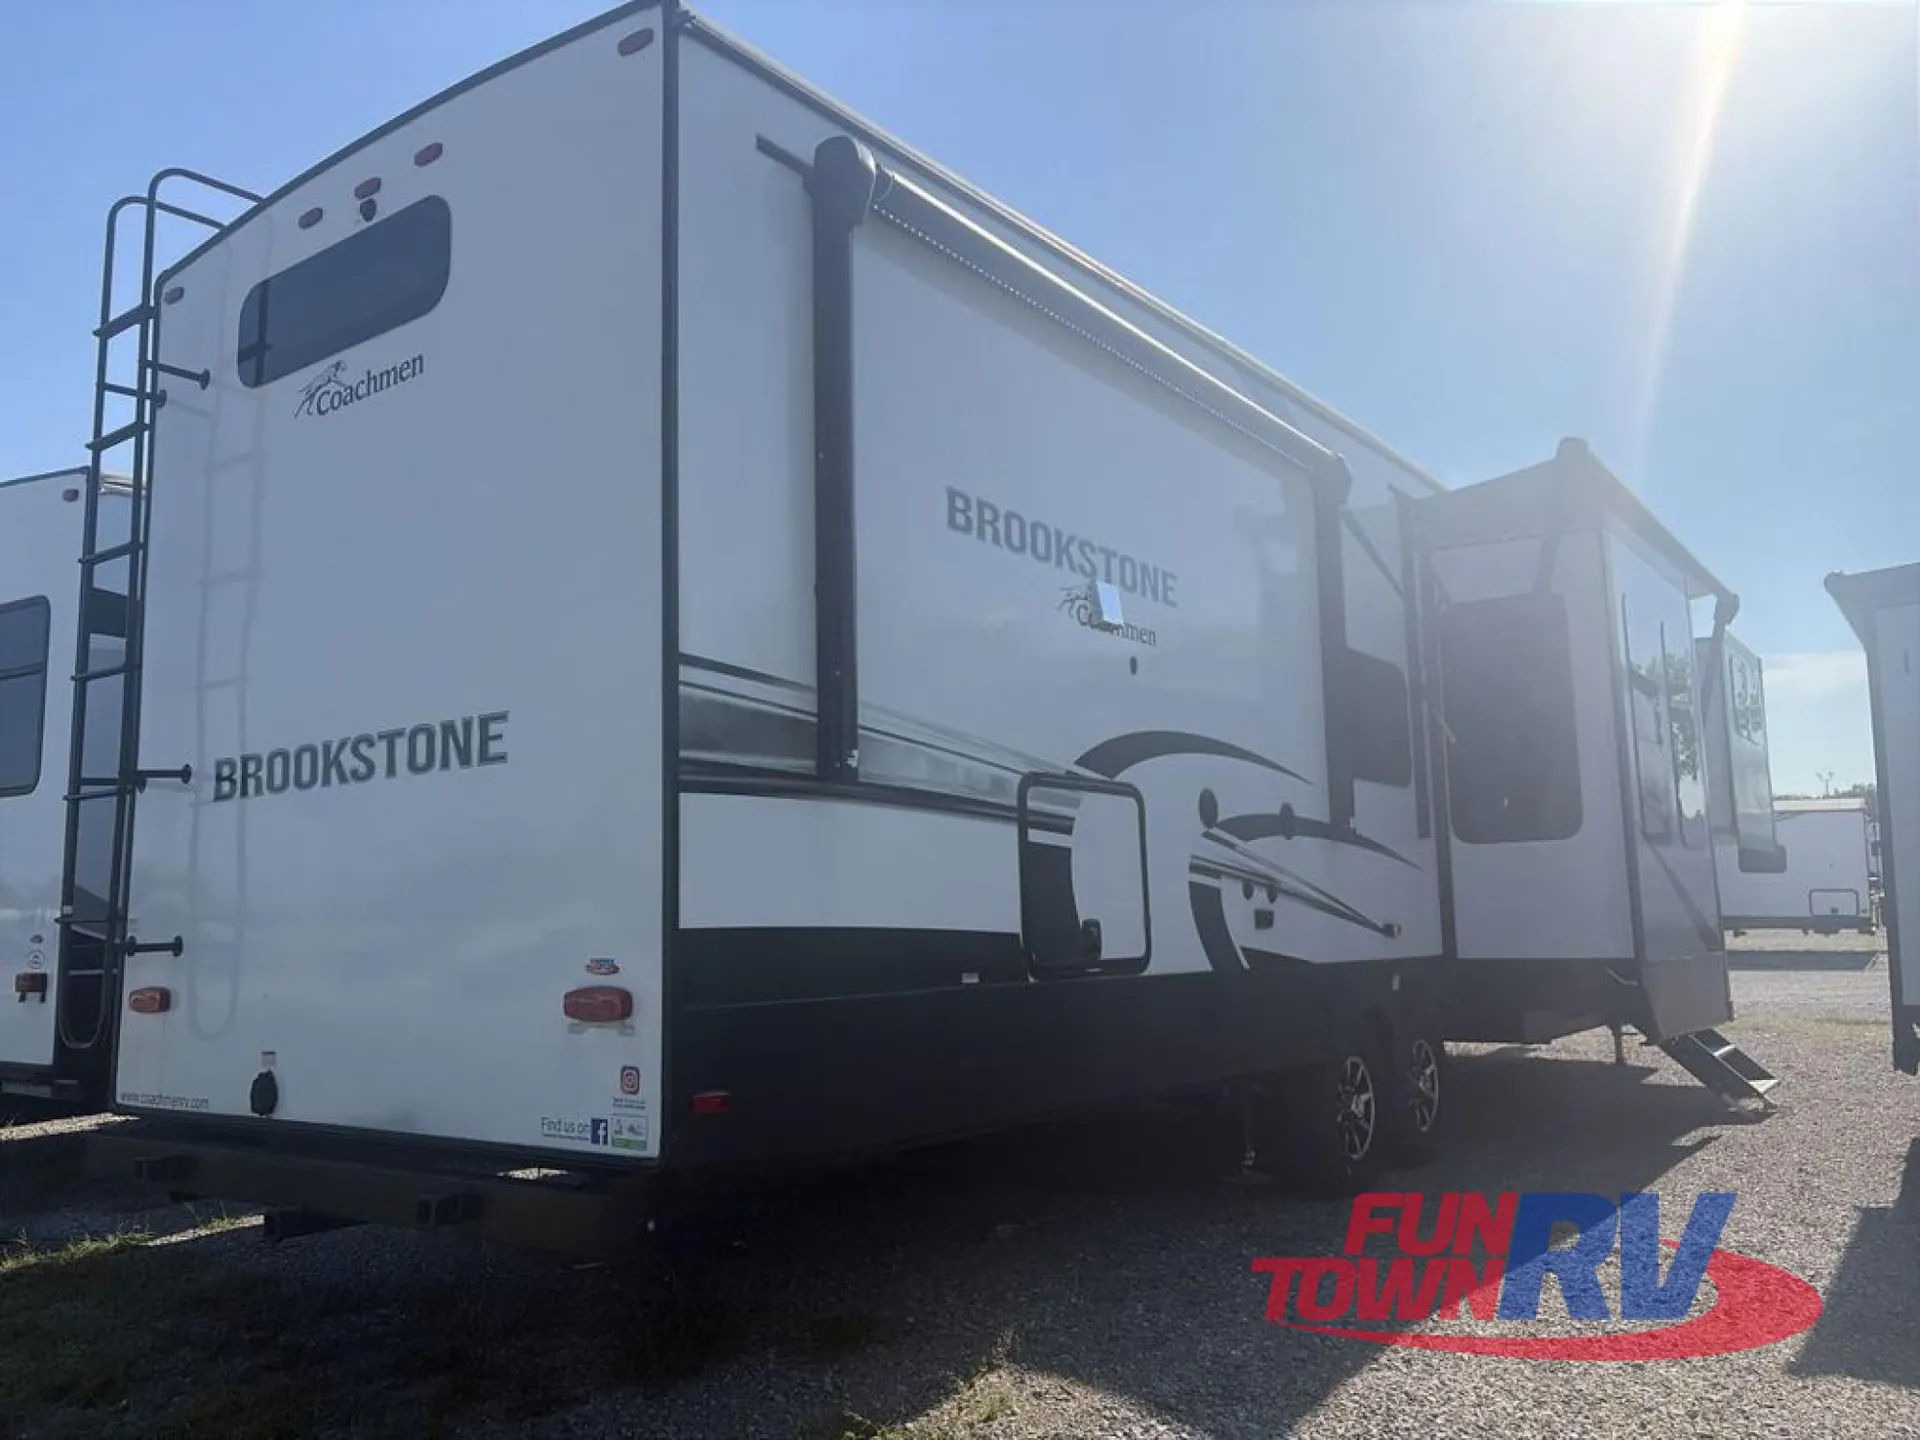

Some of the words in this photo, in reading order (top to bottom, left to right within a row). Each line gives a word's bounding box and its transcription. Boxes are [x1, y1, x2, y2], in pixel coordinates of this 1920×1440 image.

[316, 354, 424, 416] Coachmen
[946, 485, 1179, 608] BROOKSTONE
[213, 710, 510, 803] BROOKSTONE
[541, 1116, 562, 1132] Find
[564, 1120, 575, 1133] us
